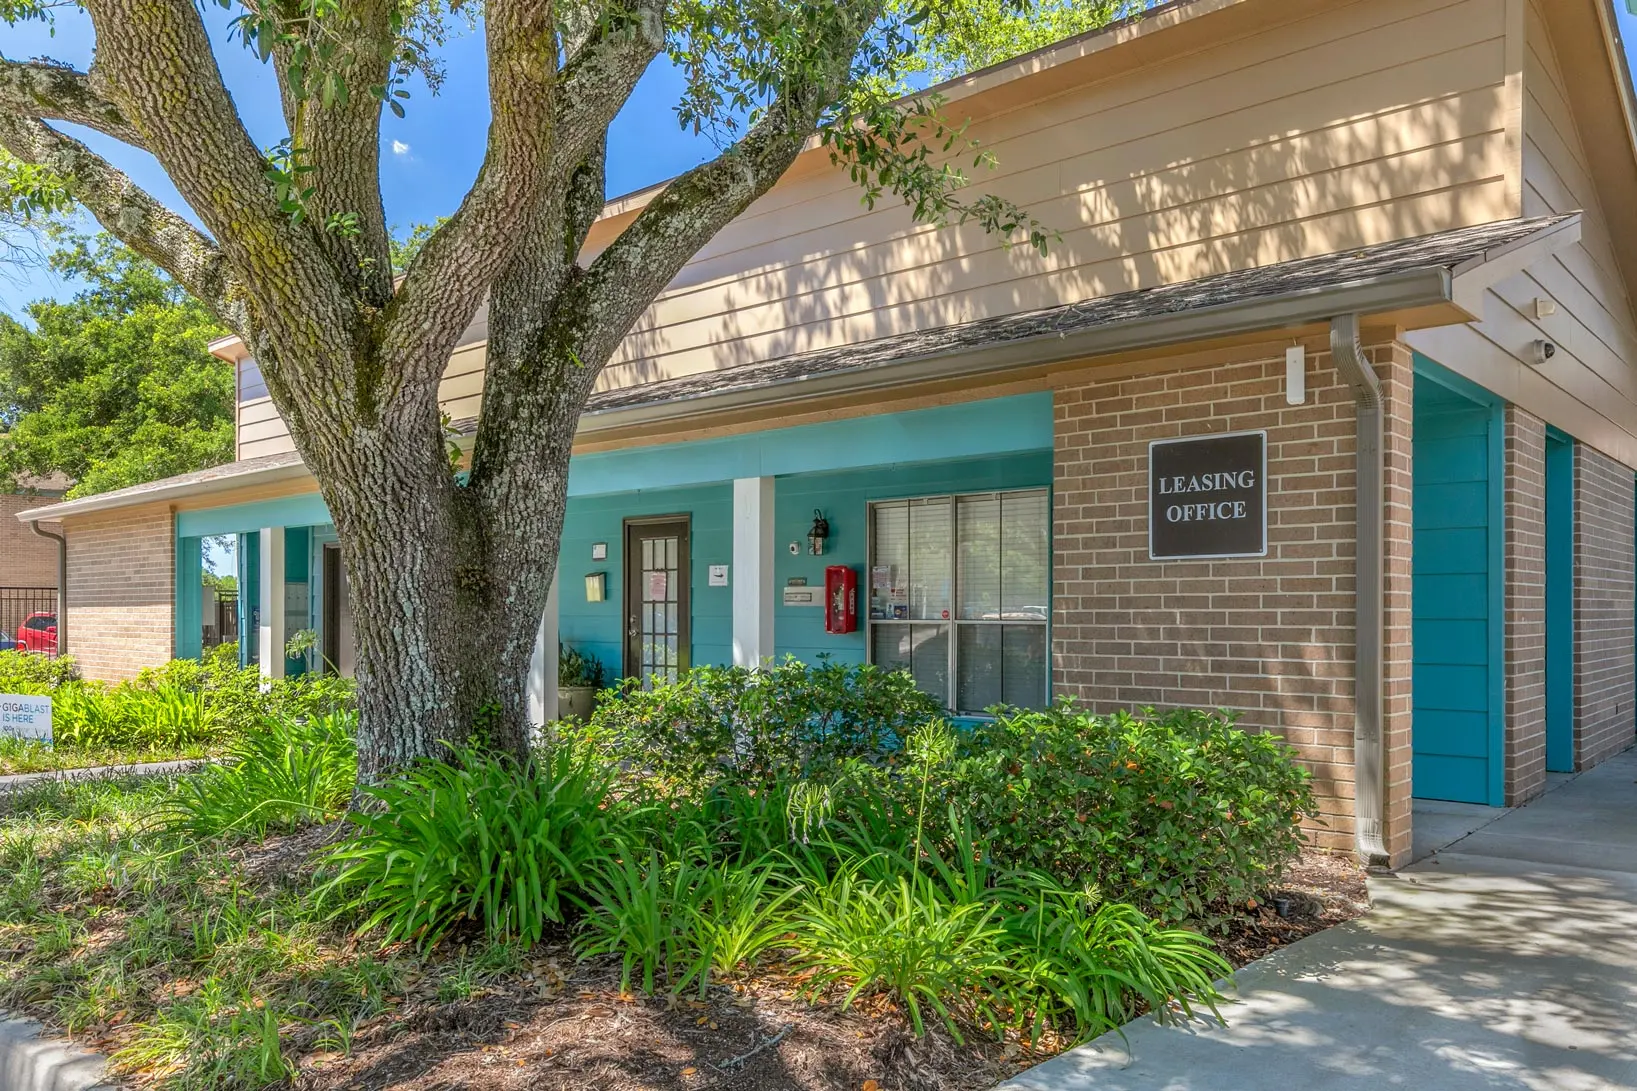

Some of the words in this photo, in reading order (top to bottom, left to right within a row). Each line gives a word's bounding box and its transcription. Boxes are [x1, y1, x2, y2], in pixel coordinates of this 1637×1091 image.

[1159, 470, 1255, 494] LEASING
[1166, 501, 1247, 522] OFFICE
[2, 714, 10, 722] IS
[12, 714, 34, 724] HERE
